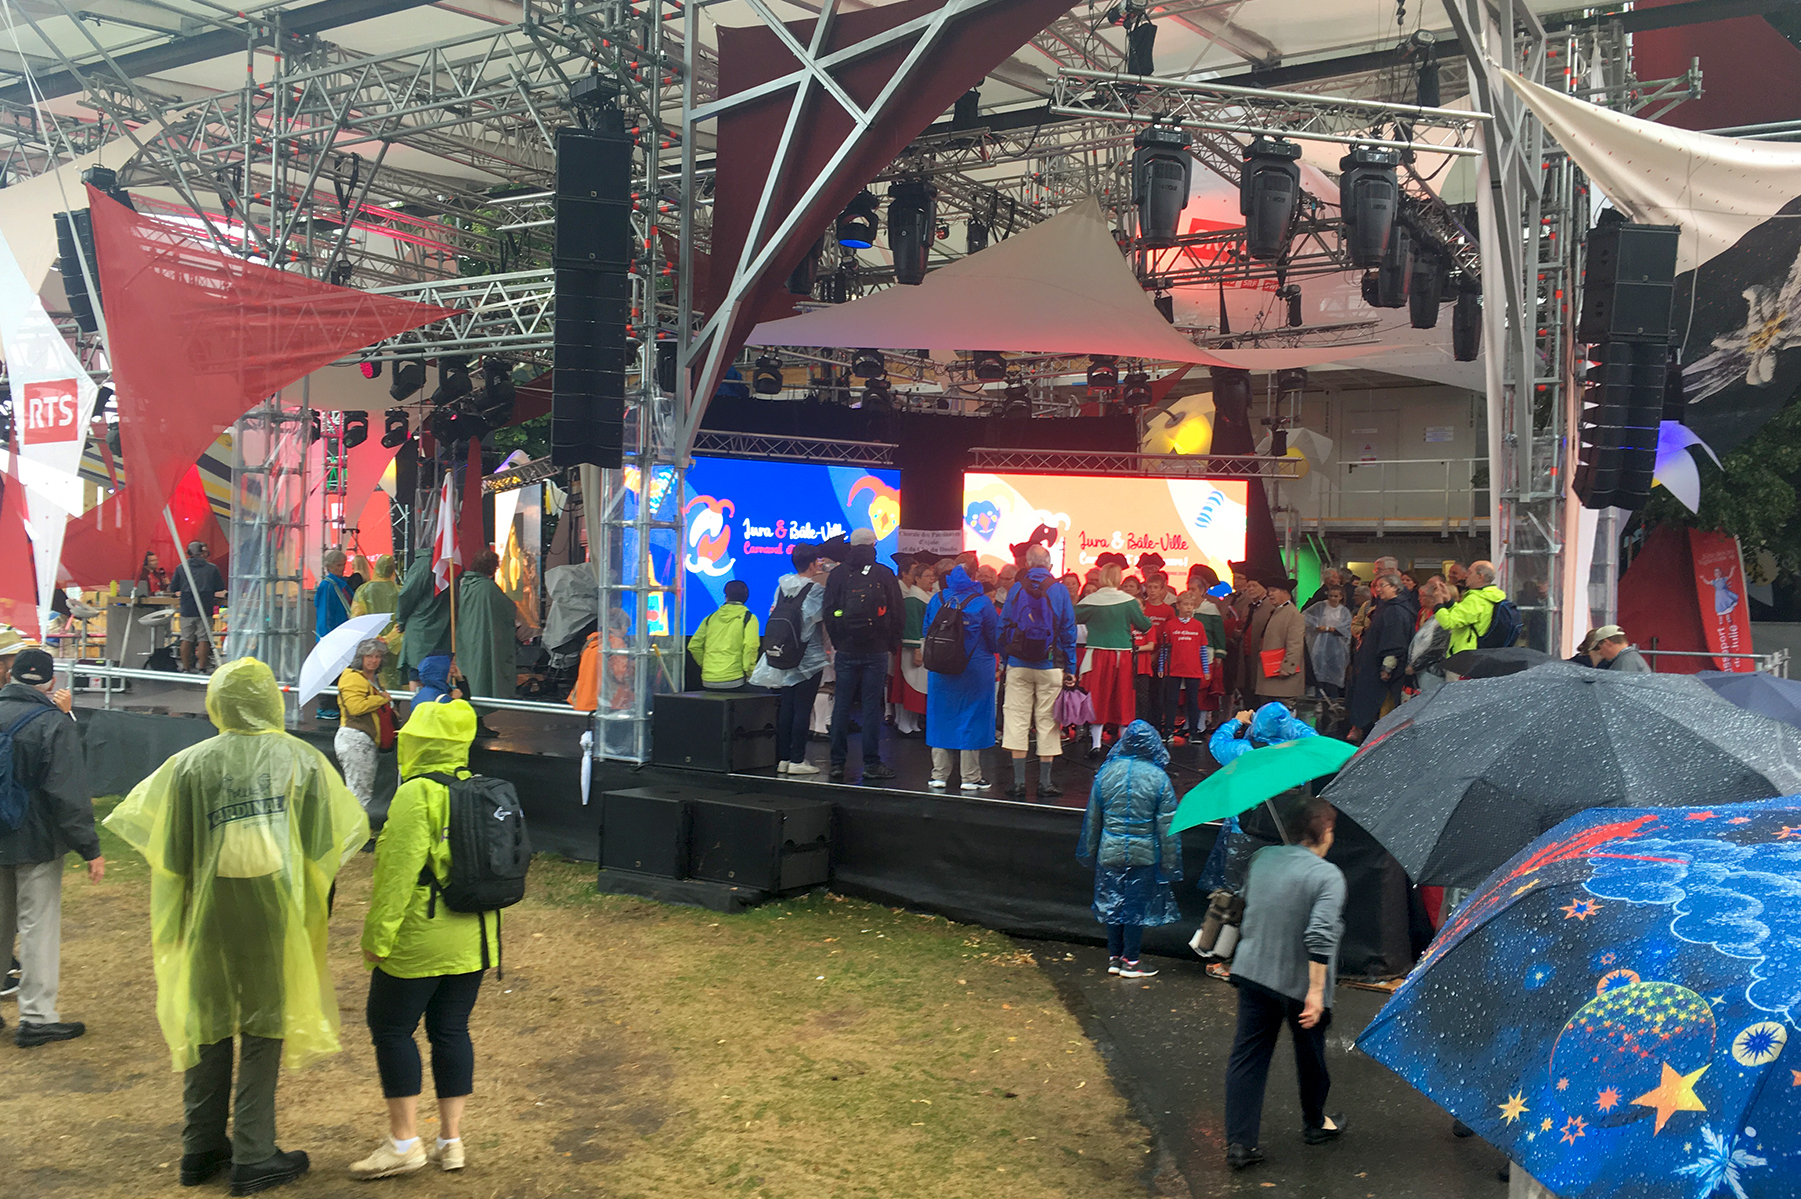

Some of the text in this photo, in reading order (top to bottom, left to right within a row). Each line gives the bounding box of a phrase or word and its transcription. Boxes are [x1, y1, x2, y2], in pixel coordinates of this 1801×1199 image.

[29, 394, 73, 429] RTS
[742, 517, 774, 540] Jura
[775, 519, 788, 539] &
[743, 541, 784, 555] Carnaval
[1078, 530, 1189, 551] Jura & Bâle-Ville
[211, 798, 284, 826] CARDINAL
